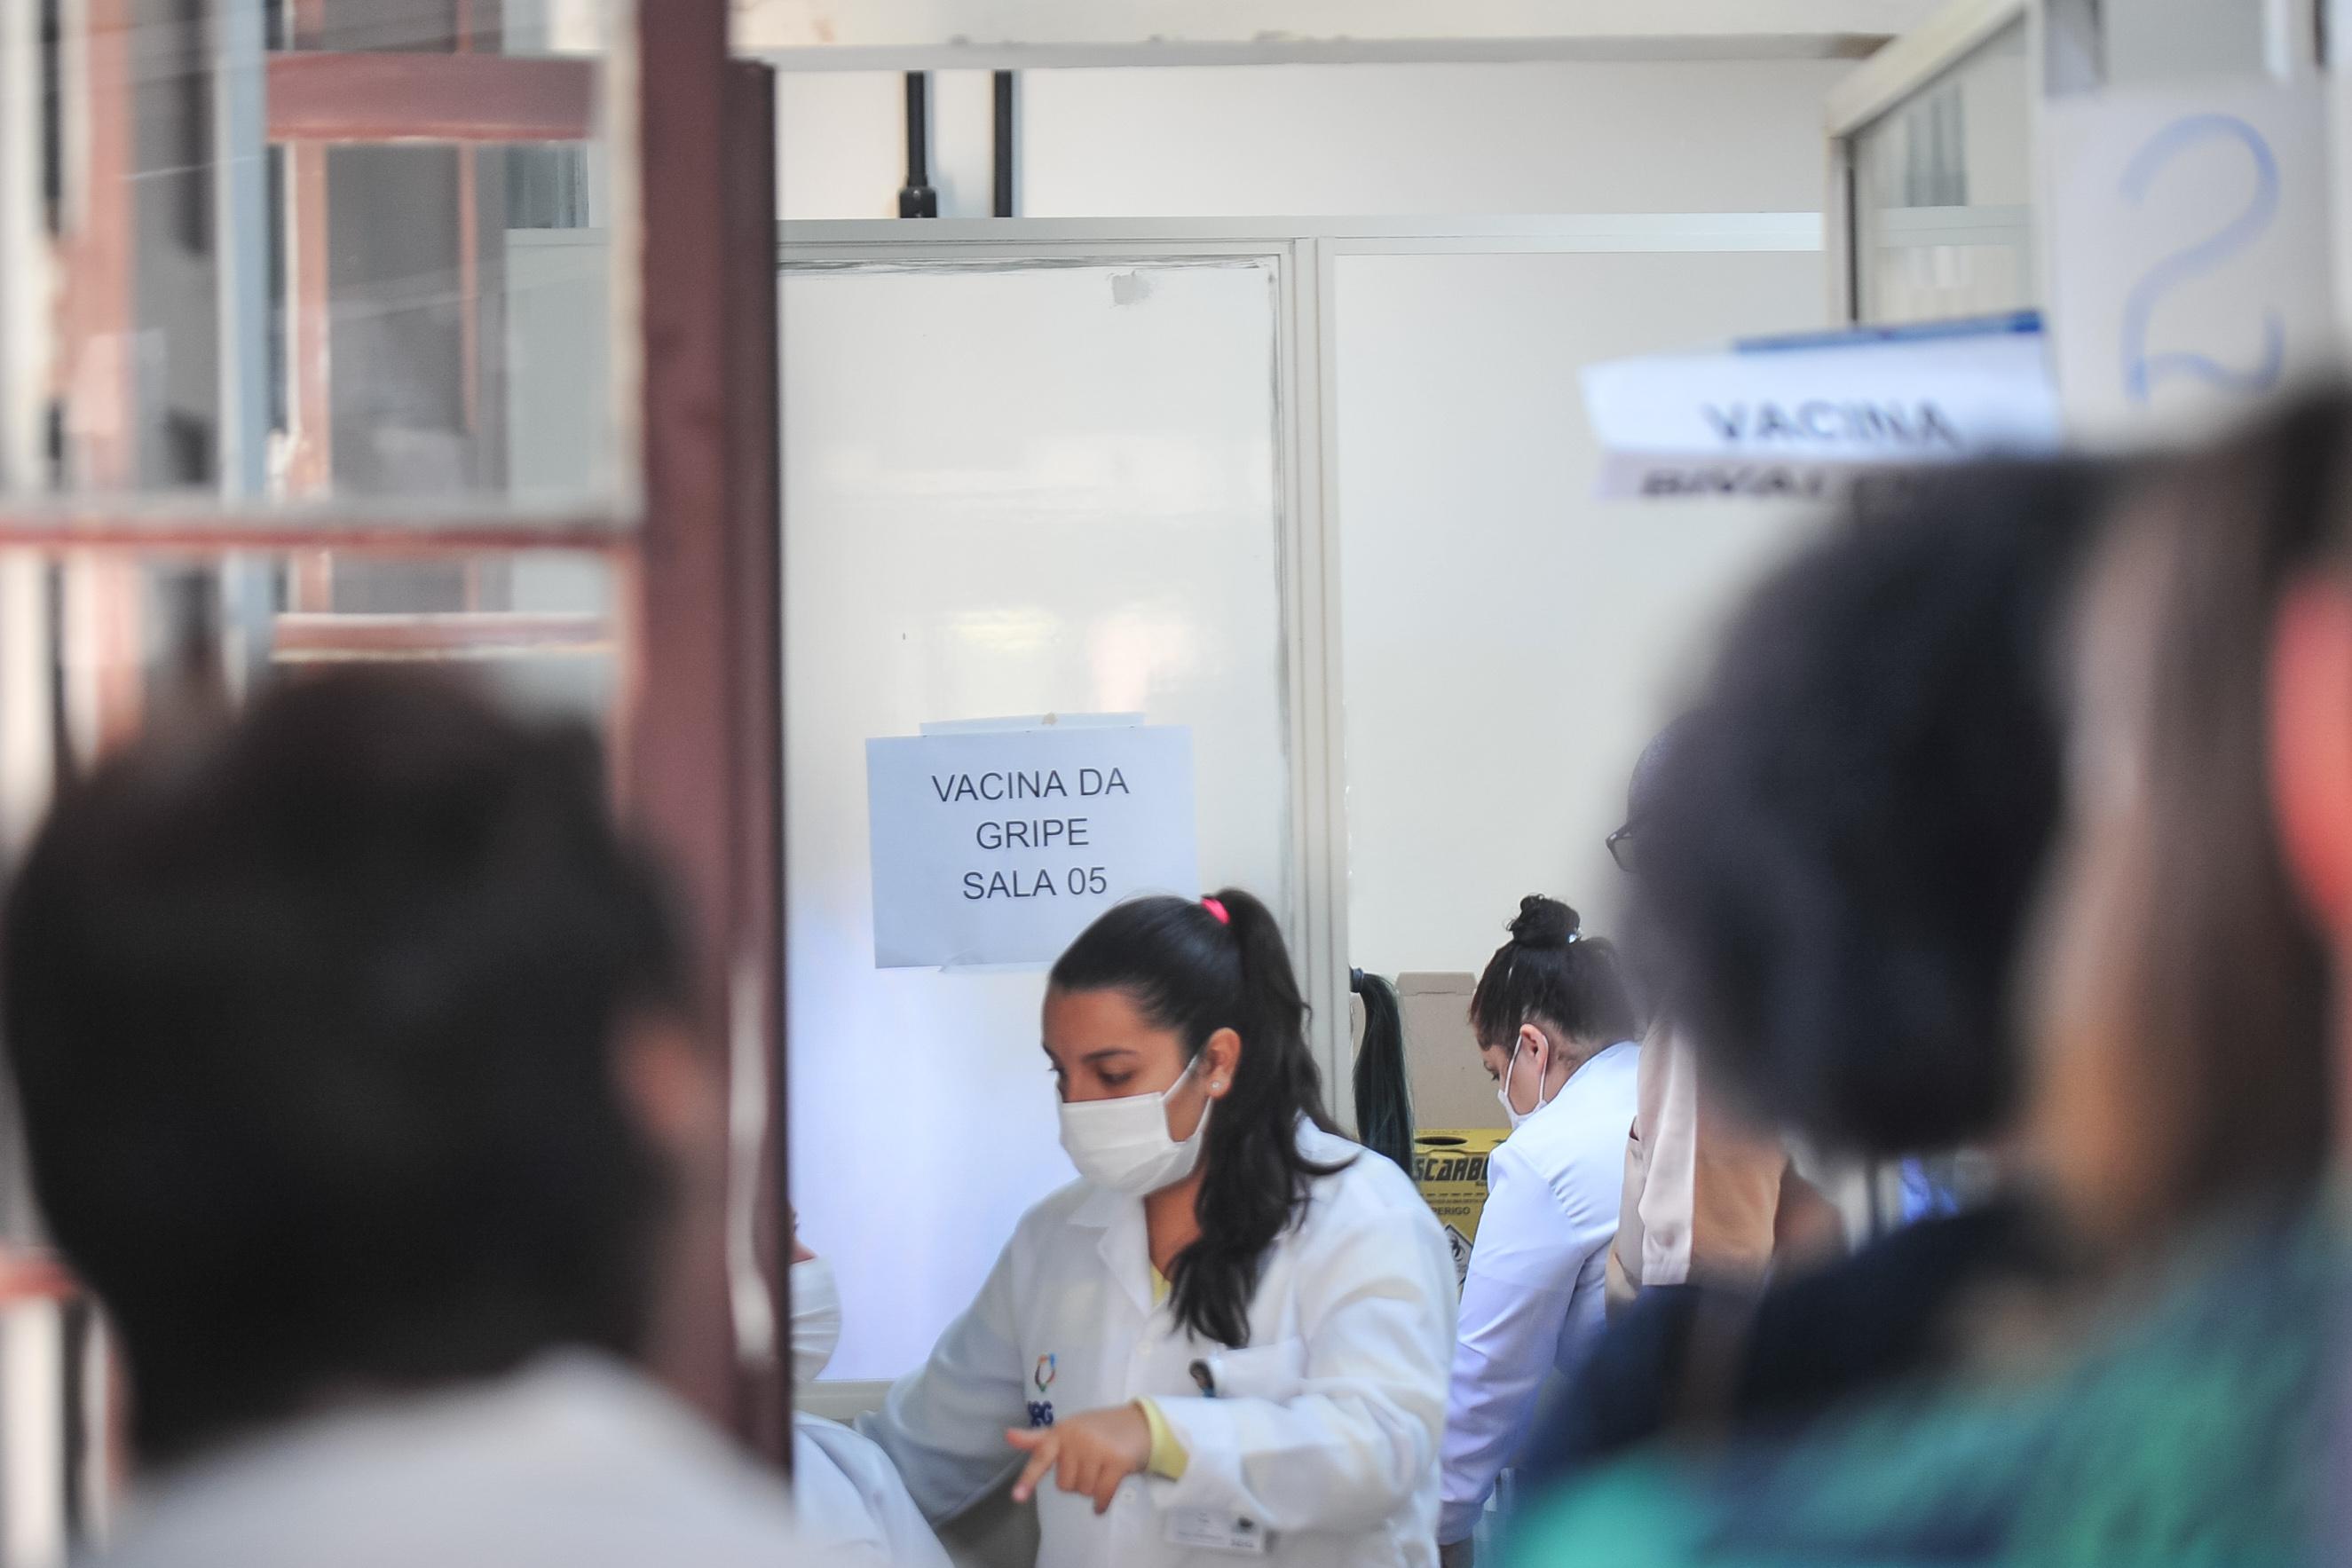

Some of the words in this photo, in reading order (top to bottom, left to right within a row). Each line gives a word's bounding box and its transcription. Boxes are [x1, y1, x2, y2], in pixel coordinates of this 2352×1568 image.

[1700, 398, 1959, 441] VACINA
[931, 769, 1067, 803] VACINA
[1079, 767, 1130, 797] DA
[976, 817, 1090, 850] GRIPE
[962, 869, 1057, 900] SALA
[1067, 866, 1108, 895] 05
